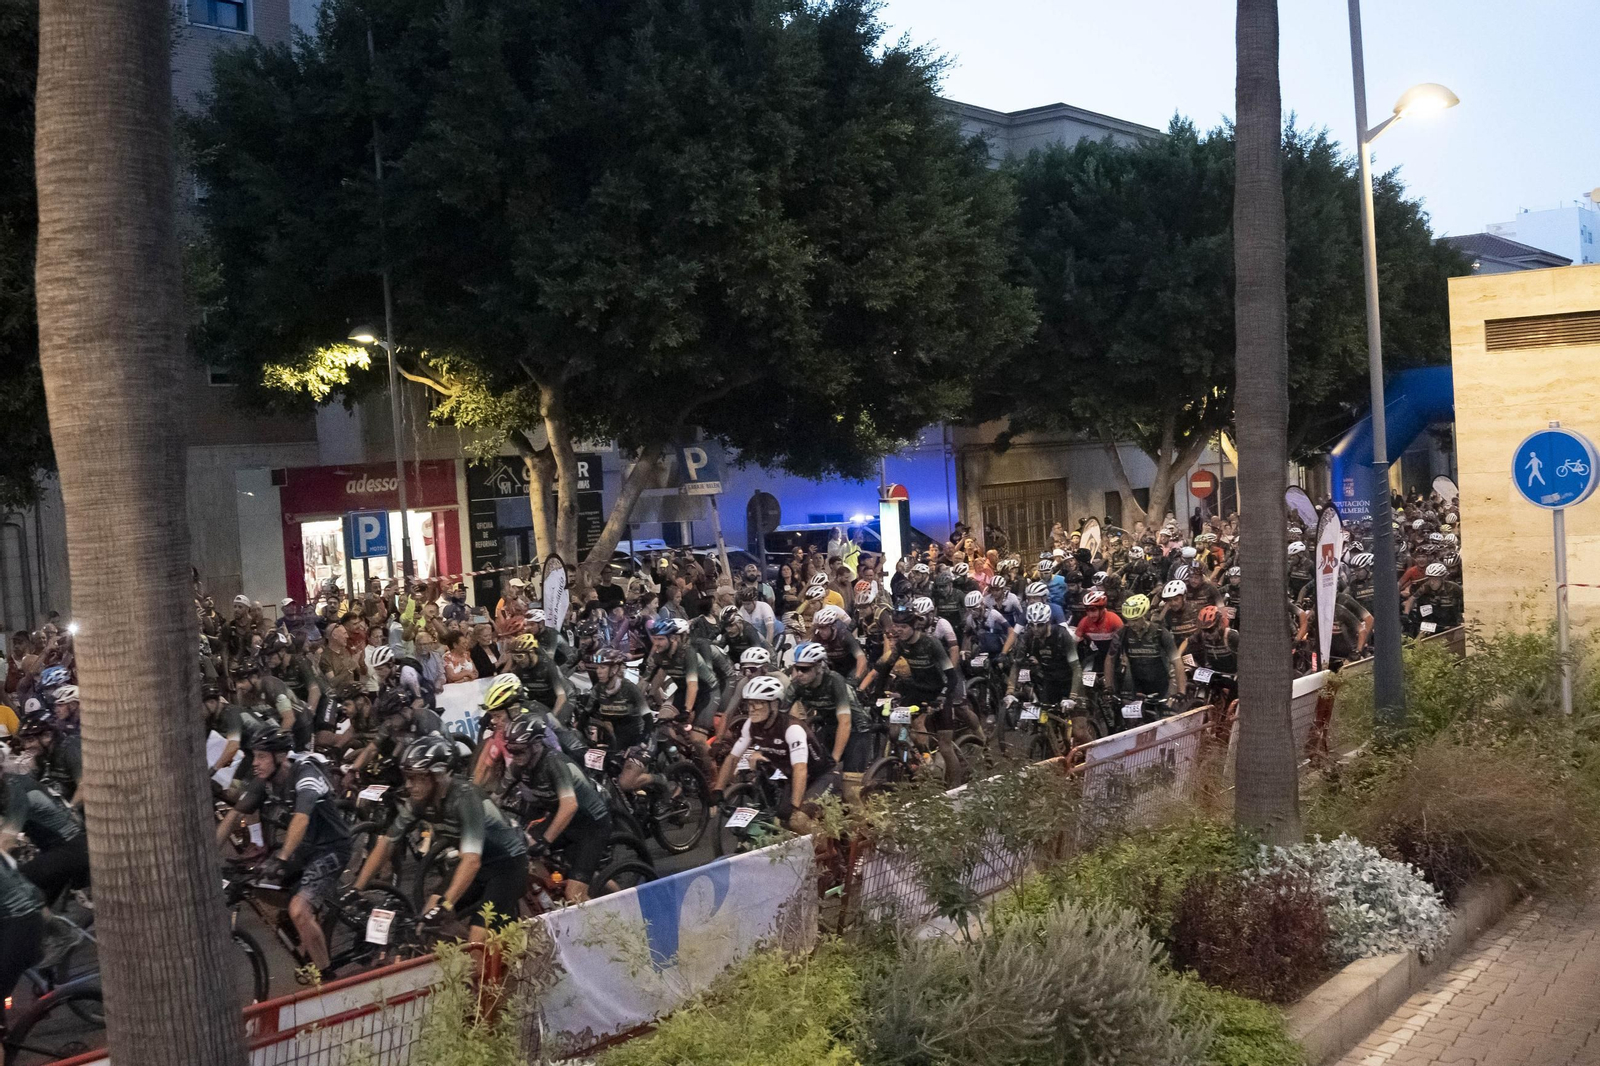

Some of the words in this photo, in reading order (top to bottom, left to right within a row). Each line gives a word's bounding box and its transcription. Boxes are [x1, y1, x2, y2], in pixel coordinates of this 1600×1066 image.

[683, 447, 708, 480] P
[346, 473, 399, 494] adesso
[476, 522, 494, 530] OFICINA
[358, 516, 381, 553] P
[482, 531, 489, 539] DE
[475, 540, 498, 549] REFORMAS
